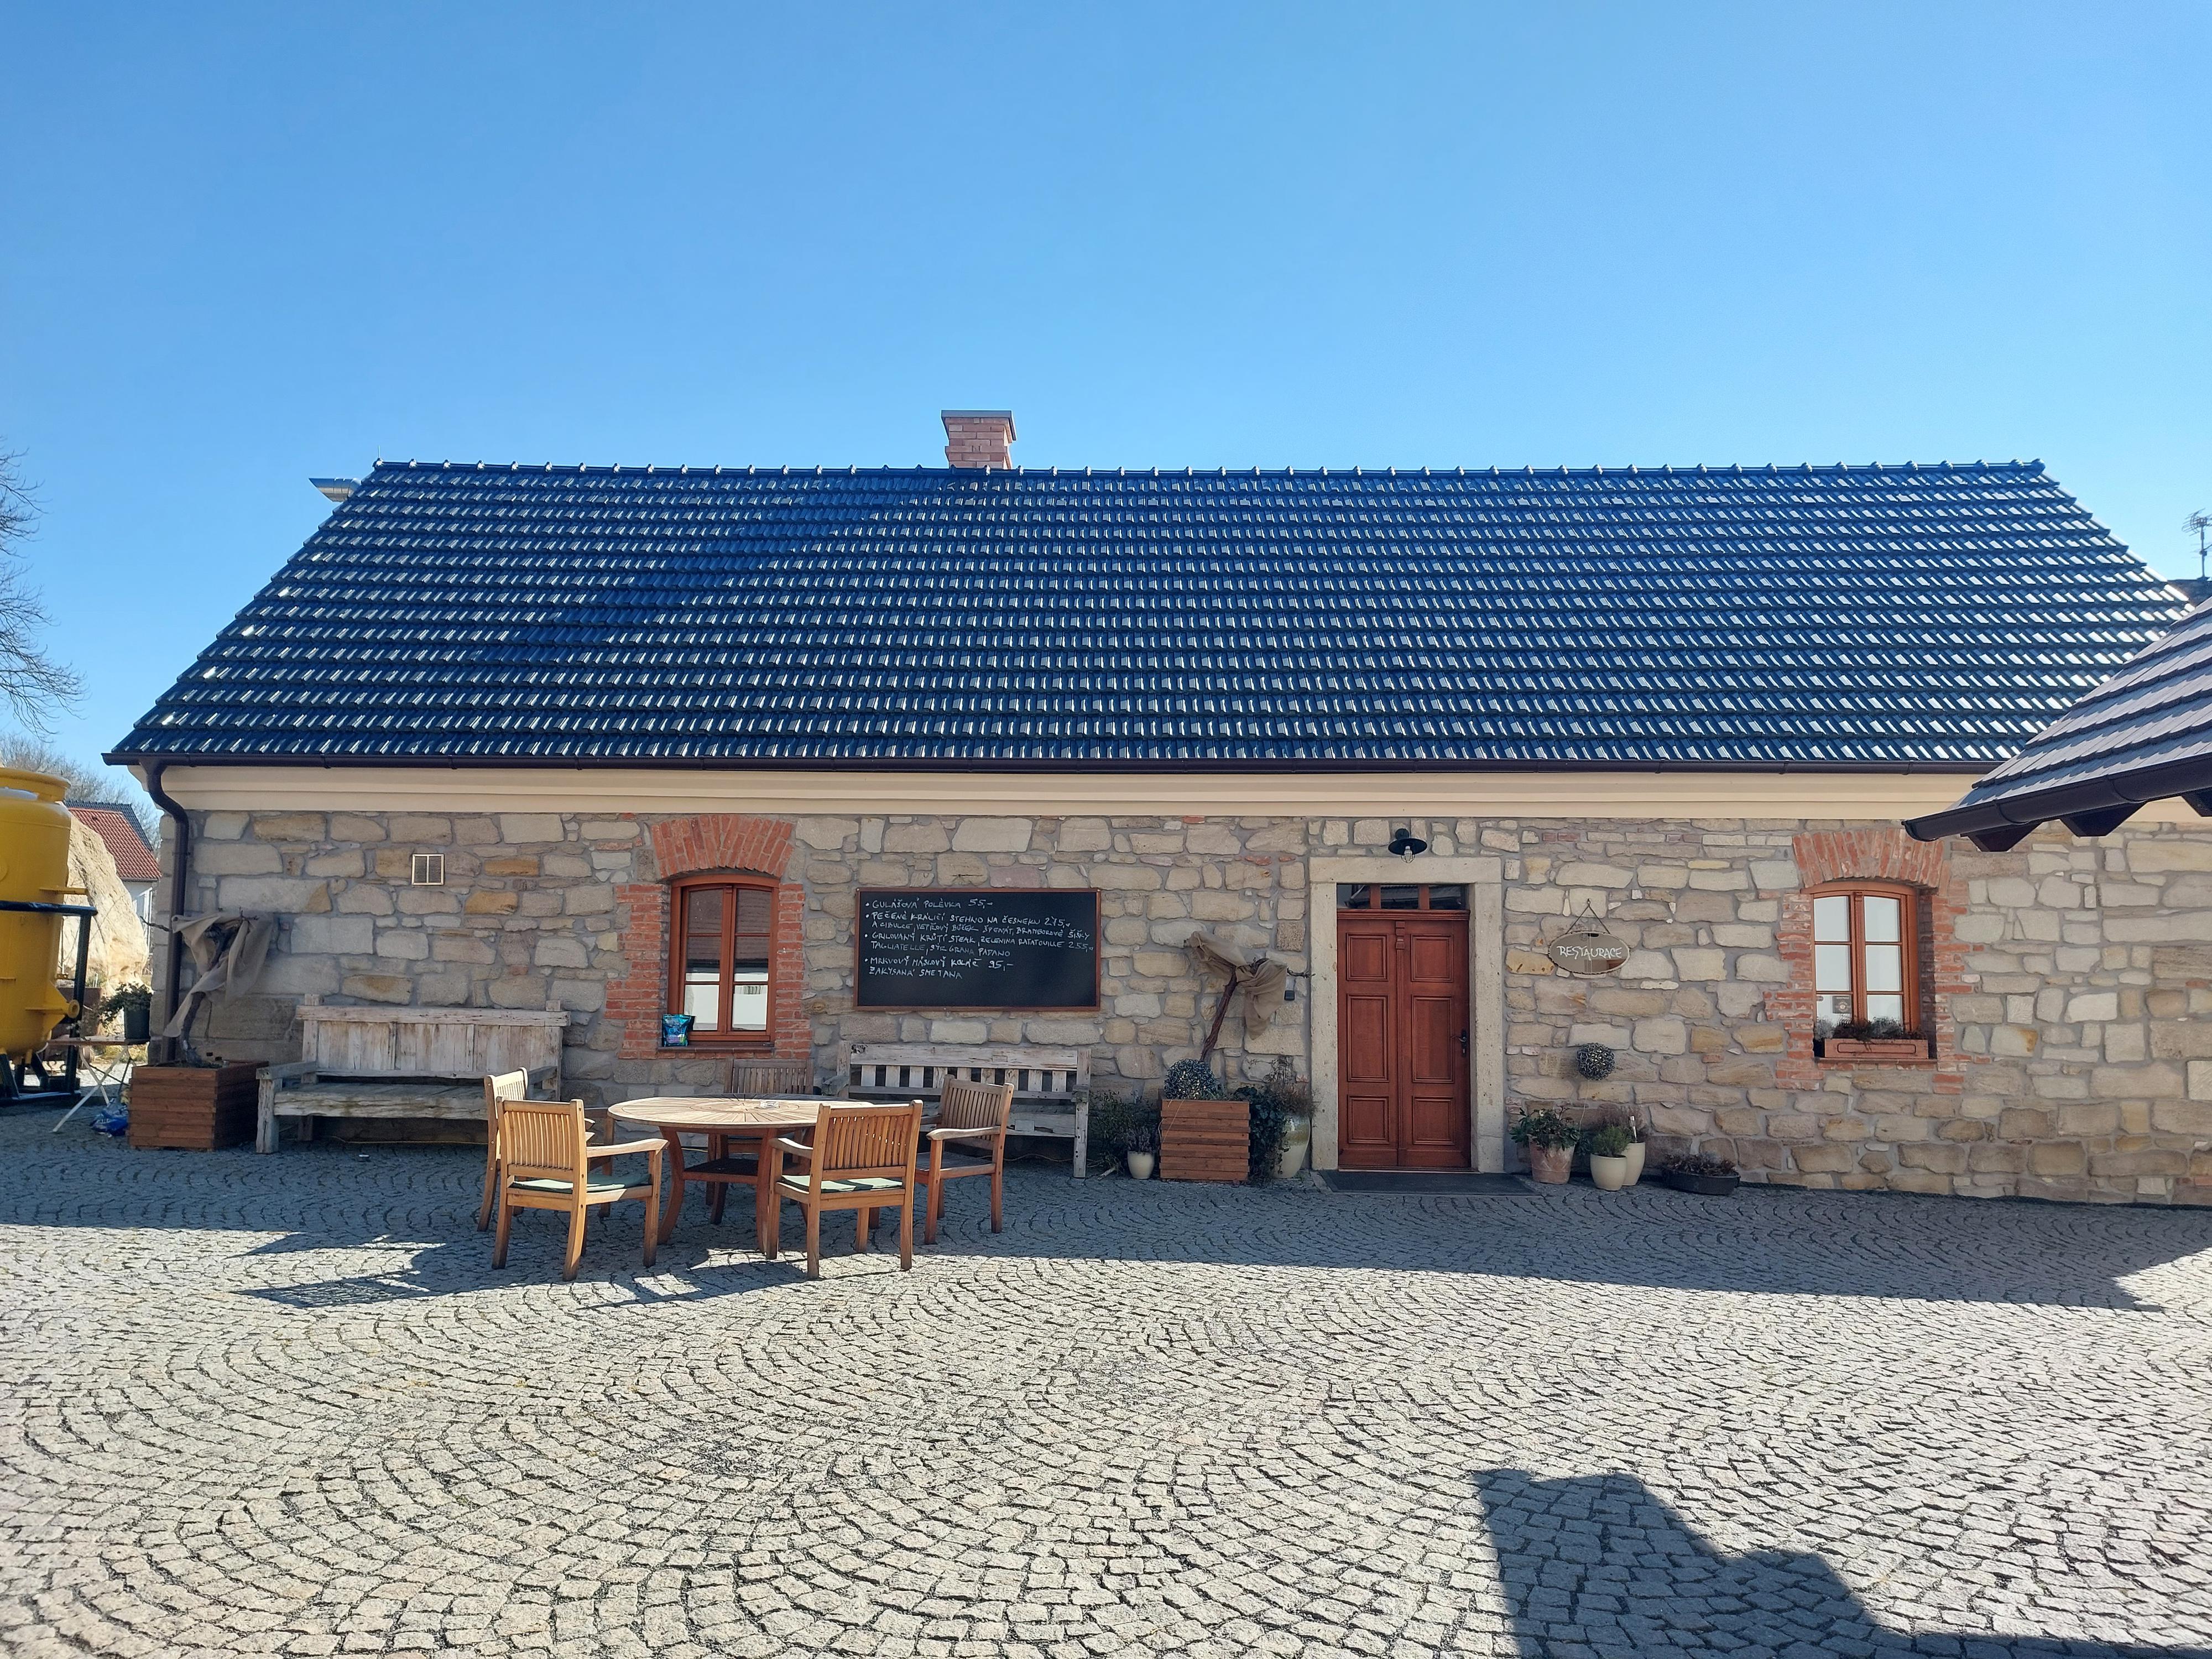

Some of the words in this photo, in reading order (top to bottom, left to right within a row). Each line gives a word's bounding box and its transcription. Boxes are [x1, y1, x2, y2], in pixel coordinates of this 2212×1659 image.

[872, 898, 919, 909] GULÁŠOVÁ
[968, 899, 993, 909] 55,-
[910, 912, 945, 921] KRÁLIČÍ
[950, 915, 983, 923] STEHNO
[1002, 915, 1040, 926] ČESNEKU
[1044, 916, 1071, 928] 275,-
[1068, 929, 1090, 940] ŠIŠKY
[870, 941, 928, 956] TAGLIATELLE,
[930, 942, 947, 951] SÝR
[949, 945, 975, 955] GRANA
[978, 948, 1010, 956] PADANO
[948, 935, 980, 947] STEAK,
[980, 936, 1015, 945] ZELENINA
[1018, 938, 1065, 947] RATATOUILLE
[1068, 941, 1094, 953] 255,-
[1556, 946, 1623, 961] RESTAURACE
[870, 956, 910, 966] MRKVOVÝ
[988, 960, 1014, 972] 95,-
[869, 966, 915, 977] ZAKYSANÁ
[919, 969, 962, 979] SMETANA
